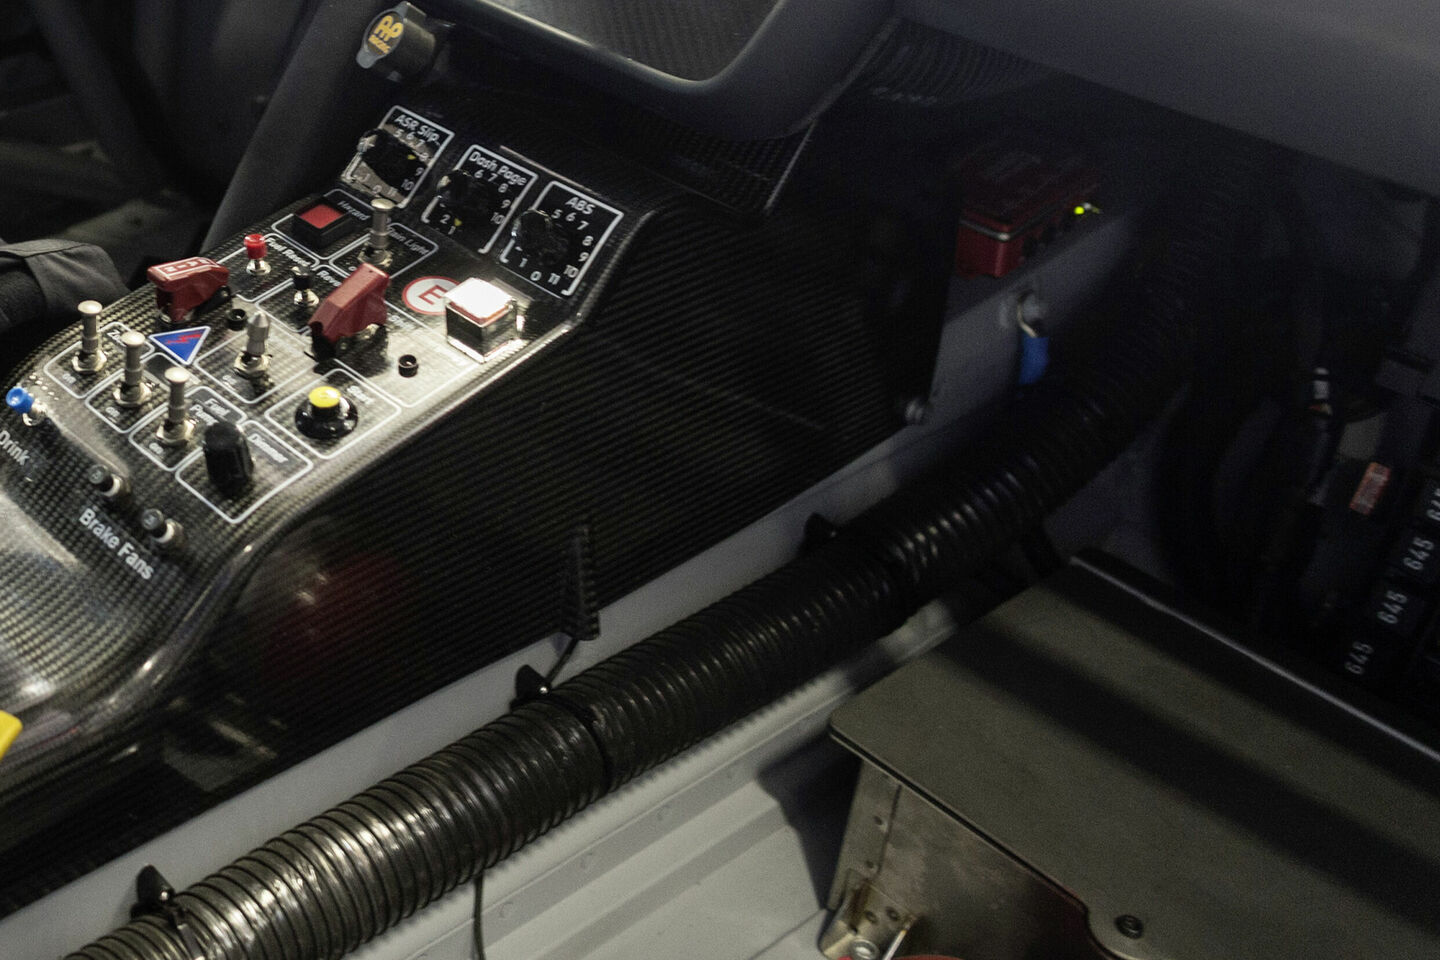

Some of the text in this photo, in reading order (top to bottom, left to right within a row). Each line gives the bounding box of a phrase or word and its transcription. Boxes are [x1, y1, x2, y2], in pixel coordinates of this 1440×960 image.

[394, 114, 440, 143] ASR Slip
[468, 151, 527, 186] Dash Page
[474, 169, 485, 178] 6
[488, 172, 498, 182] 7
[401, 179, 415, 191] 10
[498, 183, 508, 193] 8
[337, 200, 371, 220] Hazard
[501, 199, 511, 209] 9
[564, 196, 596, 215] ABS
[440, 214, 451, 224] 2
[490, 212, 505, 225] 10
[551, 209, 563, 219] 5
[565, 212, 577, 222] 6
[577, 220, 589, 230] 7
[264, 236, 288, 252] Fuel
[404, 239, 430, 255] Light
[582, 235, 594, 246] 8
[519, 257, 528, 268] 1
[578, 251, 590, 262] 9
[529, 271, 542, 281] 0
[563, 264, 579, 278] 10
[316, 270, 343, 287] Reve
[547, 272, 561, 285] 11
[418, 284, 448, 306] E
[204, 398, 231, 417] Fuel
[189, 404, 220, 426] Pum
[78, 507, 155, 580] Brake Fans
[1403, 537, 1435, 571] 645
[1377, 590, 1408, 625] 645
[1344, 640, 1375, 675] 645
